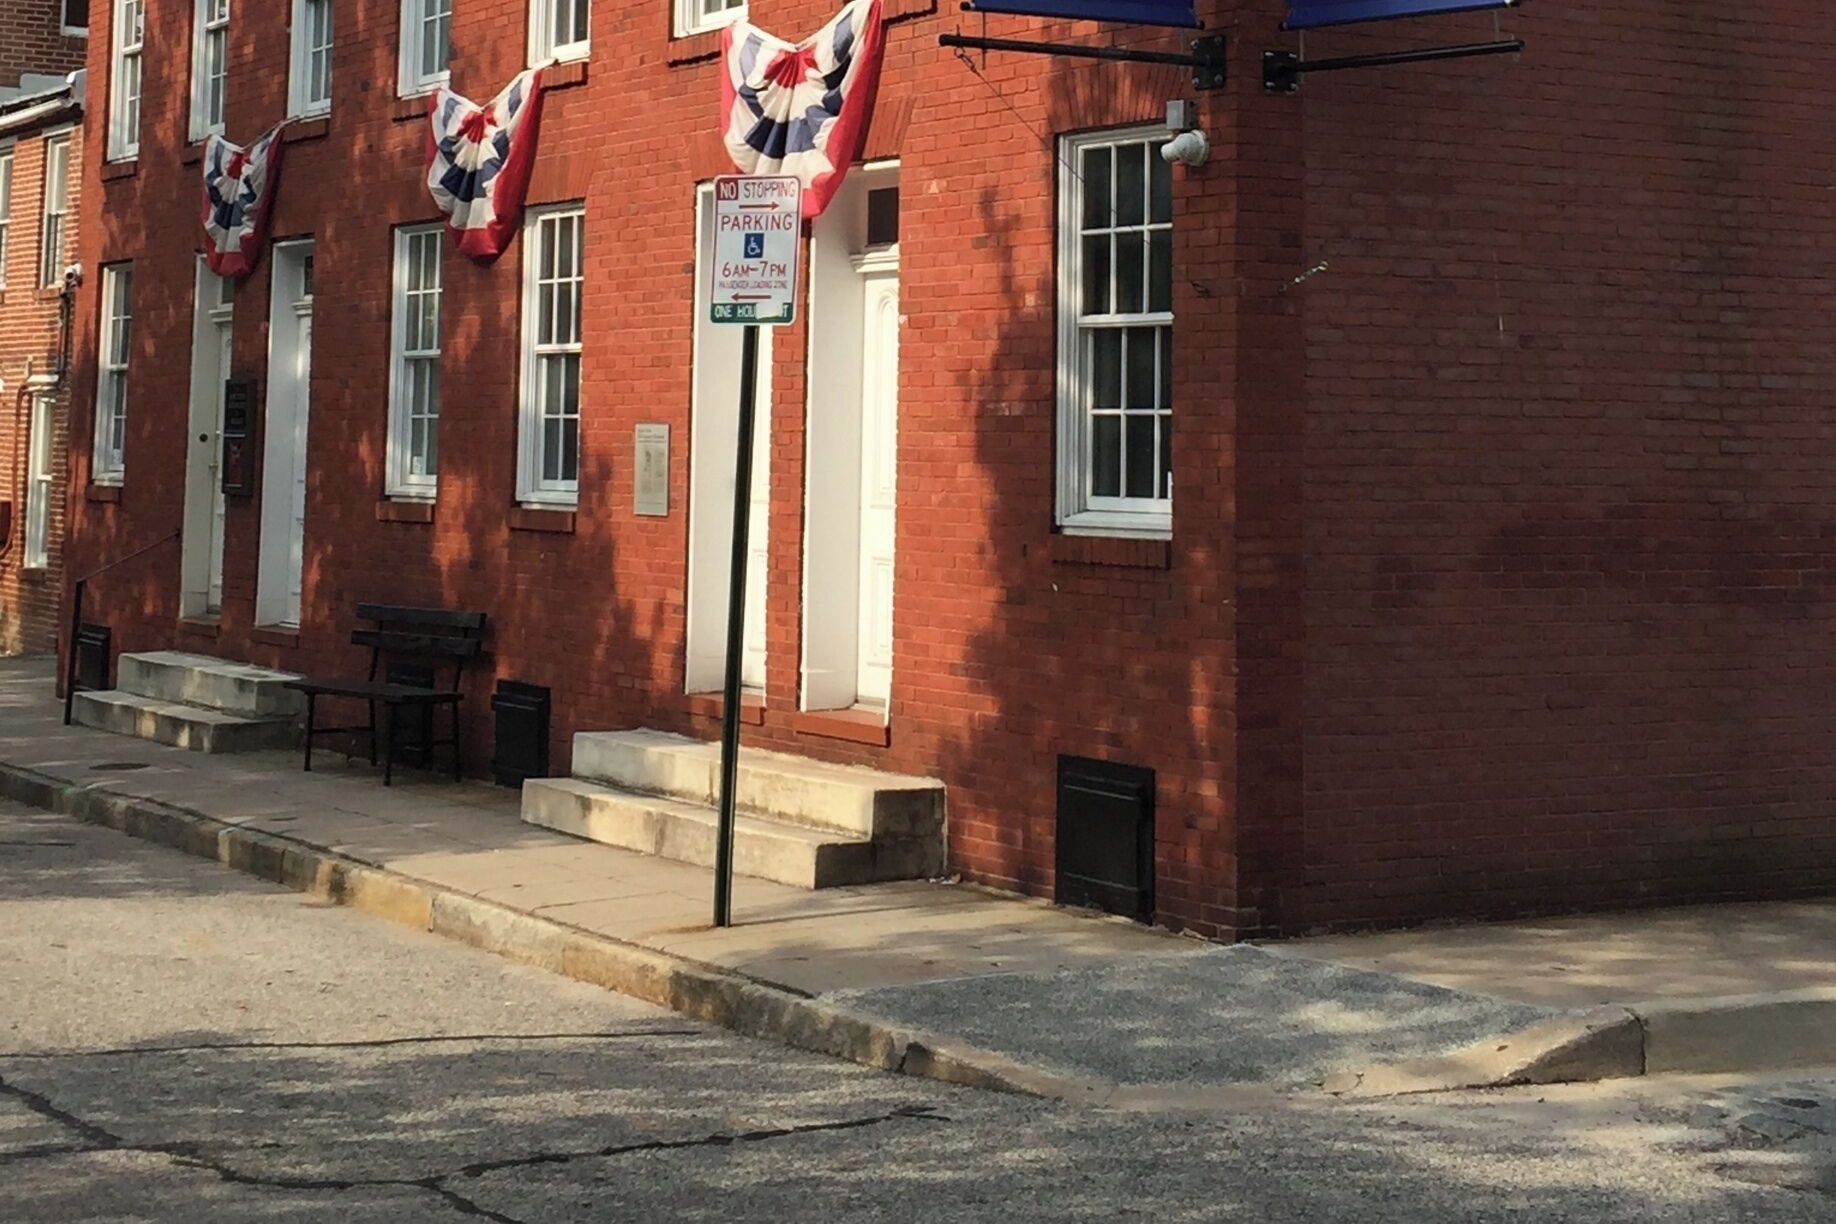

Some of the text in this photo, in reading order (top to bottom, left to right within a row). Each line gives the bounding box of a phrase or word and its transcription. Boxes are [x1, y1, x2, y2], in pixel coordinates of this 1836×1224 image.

[720, 181, 796, 199] NO STOPPING
[720, 213, 793, 231] PARKING
[714, 305, 733, 318] ONE
